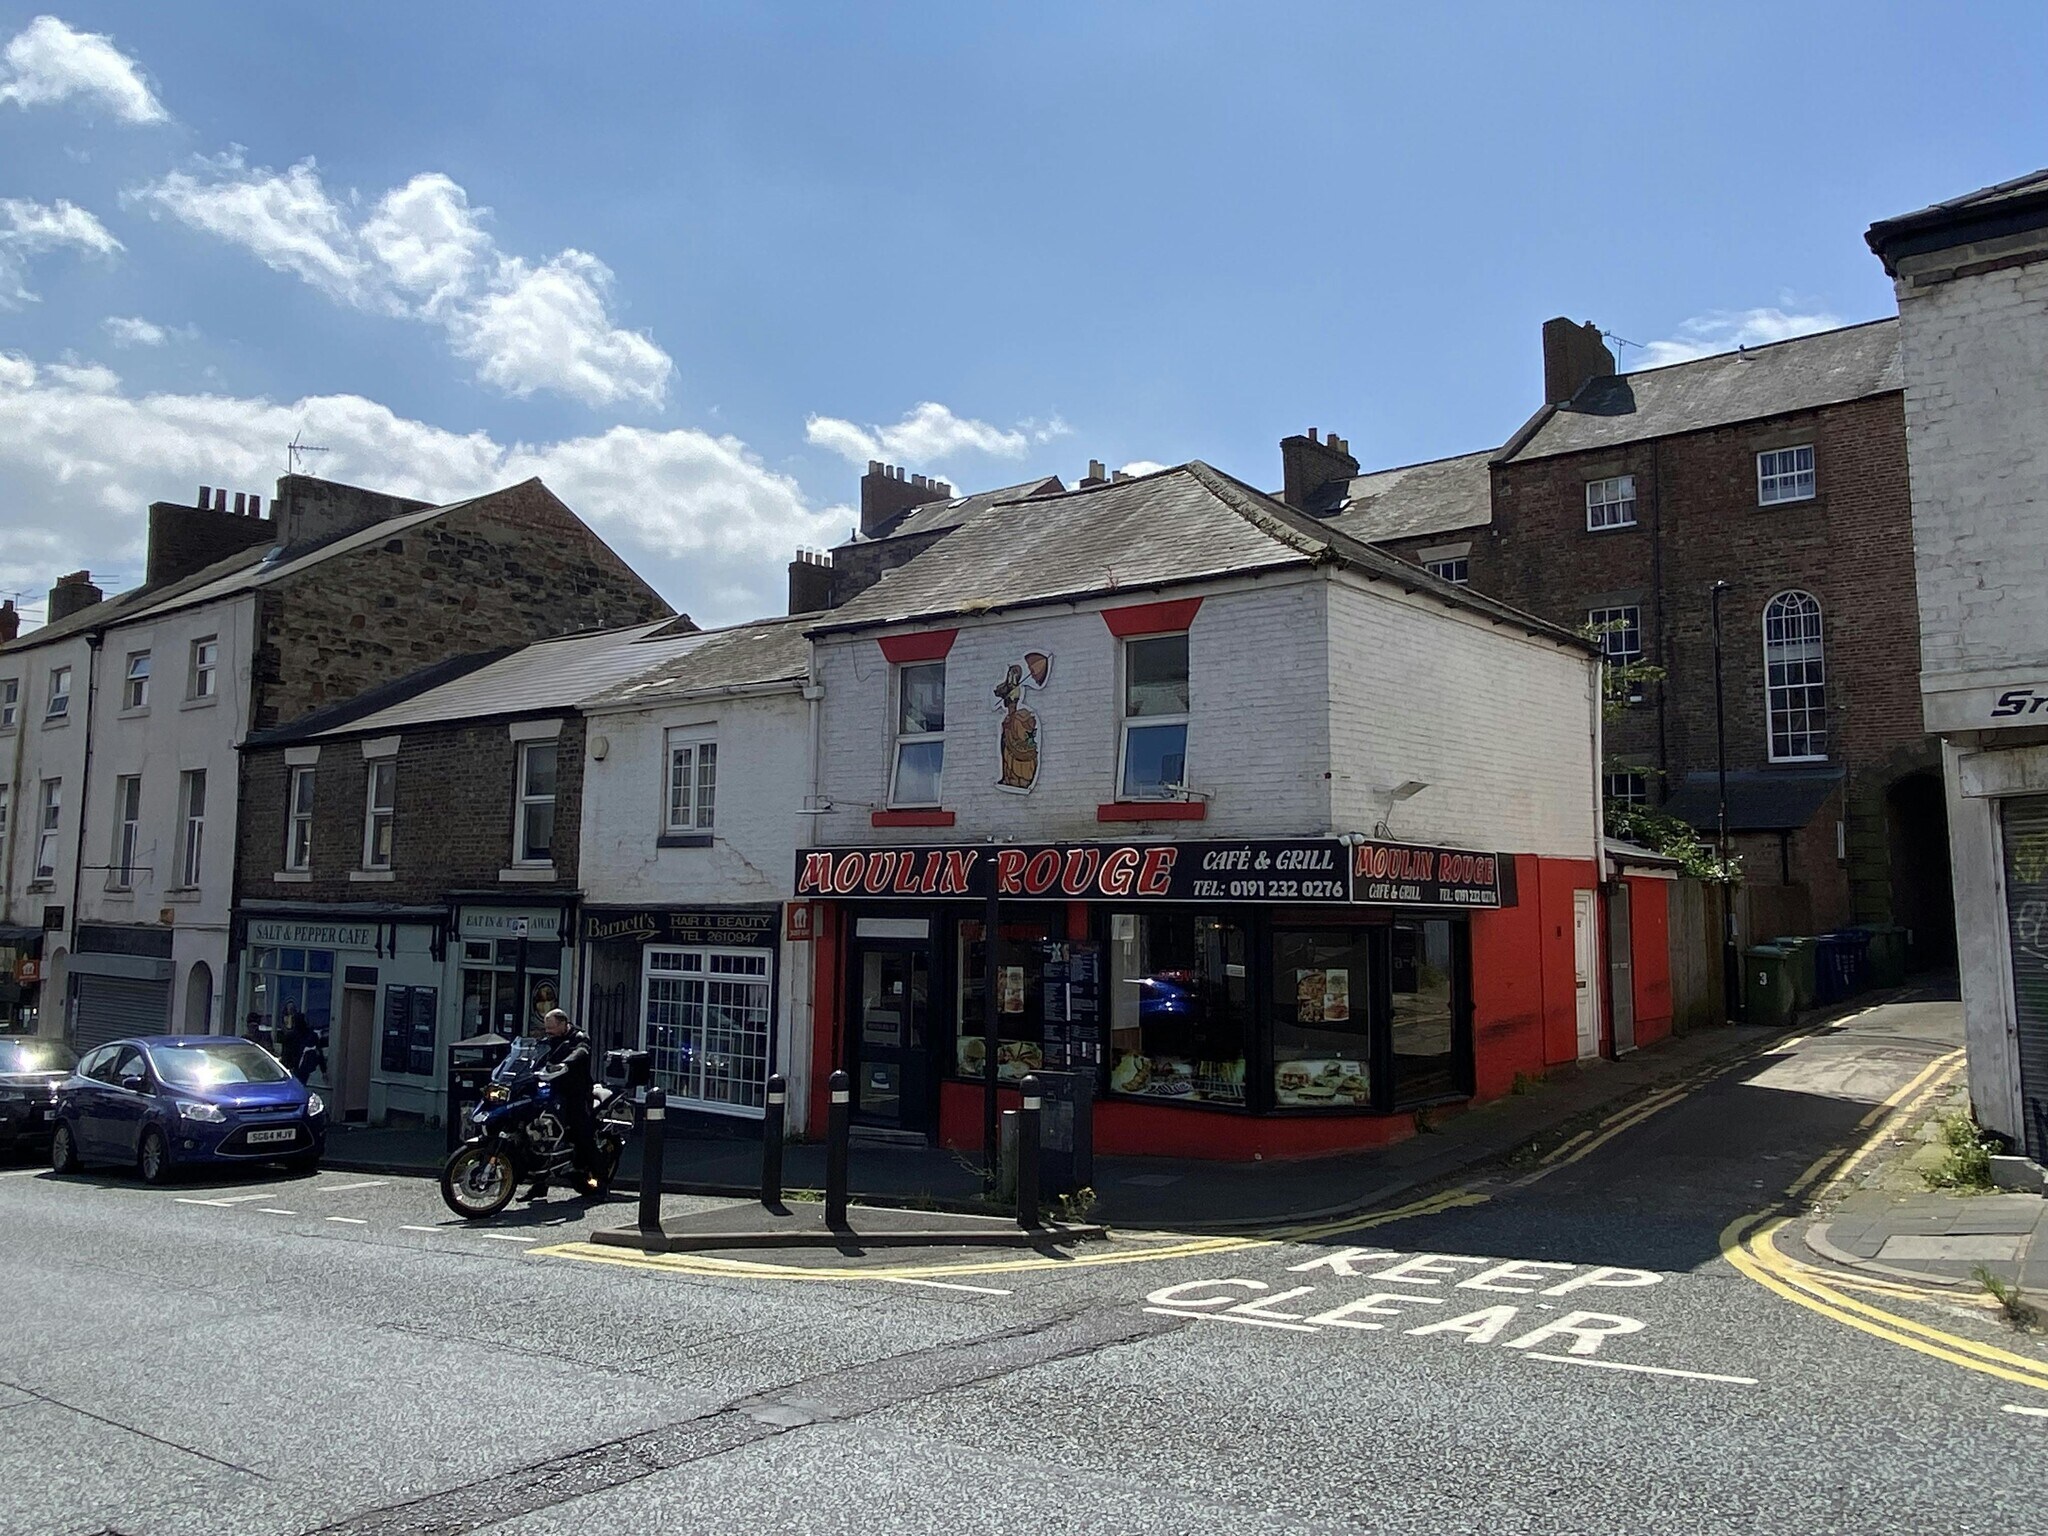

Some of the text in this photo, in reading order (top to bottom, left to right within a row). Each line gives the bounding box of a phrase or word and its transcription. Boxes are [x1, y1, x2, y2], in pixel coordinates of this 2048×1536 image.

[1202, 845, 1334, 870] CAFÉ & GRILL
[1355, 846, 1495, 885] MOULIN ROUGE
[798, 847, 1178, 895] MOULIN ROUGE
[1193, 880, 1343, 897] TEL: 0191 232 0276
[1390, 885, 1398, 899] &
[1399, 885, 1421, 900] GRILL
[466, 915, 484, 927] EAT
[485, 916, 495, 928] IN
[496, 917, 503, 928] &
[530, 917, 558, 929] AWAY
[671, 917, 770, 928] HAIR & BEAUTY
[256, 924, 370, 945] SALT & PEPPER CAFE
[681, 930, 758, 943] TEL 2610947
[1759, 972, 1768, 986] 3
[1286, 1247, 1664, 1296] KEEP
[1146, 1277, 1647, 1355] CLEAR
